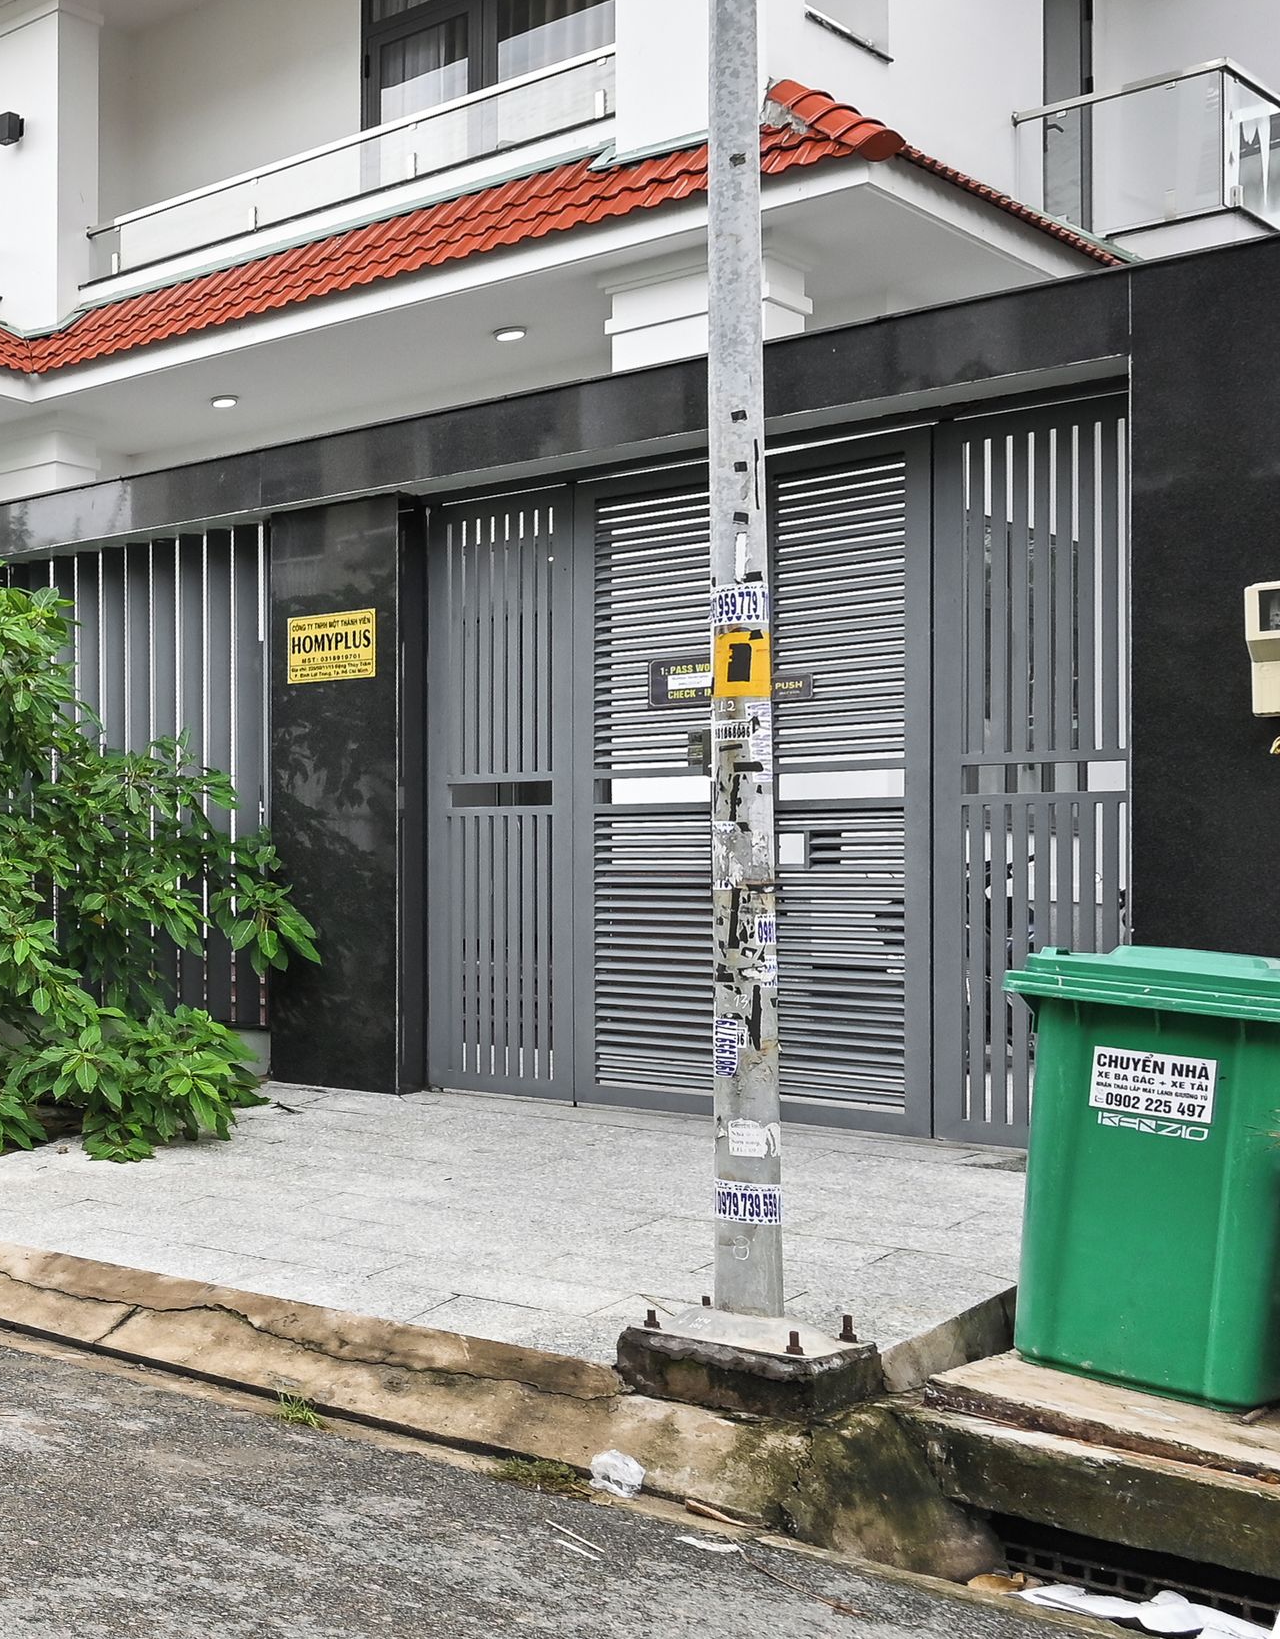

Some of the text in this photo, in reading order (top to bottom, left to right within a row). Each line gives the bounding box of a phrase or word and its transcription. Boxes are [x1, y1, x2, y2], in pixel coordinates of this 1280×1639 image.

[292, 615, 371, 632] CÔNG TY TNHH MỘT THÀNH VIÊN
[291, 629, 371, 655] HOMYPLUS
[660, 667, 668, 675] 1:
[670, 664, 694, 674] PASS
[775, 681, 803, 689] PUSH
[668, 689, 696, 699] CHECK
[734, 994, 748, 1009] 13
[1096, 1053, 1210, 1080] CHUYỂN NHÀ
[1097, 1070, 1111, 1079] XE
[1114, 1072, 1129, 1081] BA
[1132, 1074, 1155, 1086] GÁC
[1170, 1080, 1185, 1089] XE
[1190, 1081, 1208, 1092] TẢI
[1105, 1092, 1206, 1118] 0902 225 497
